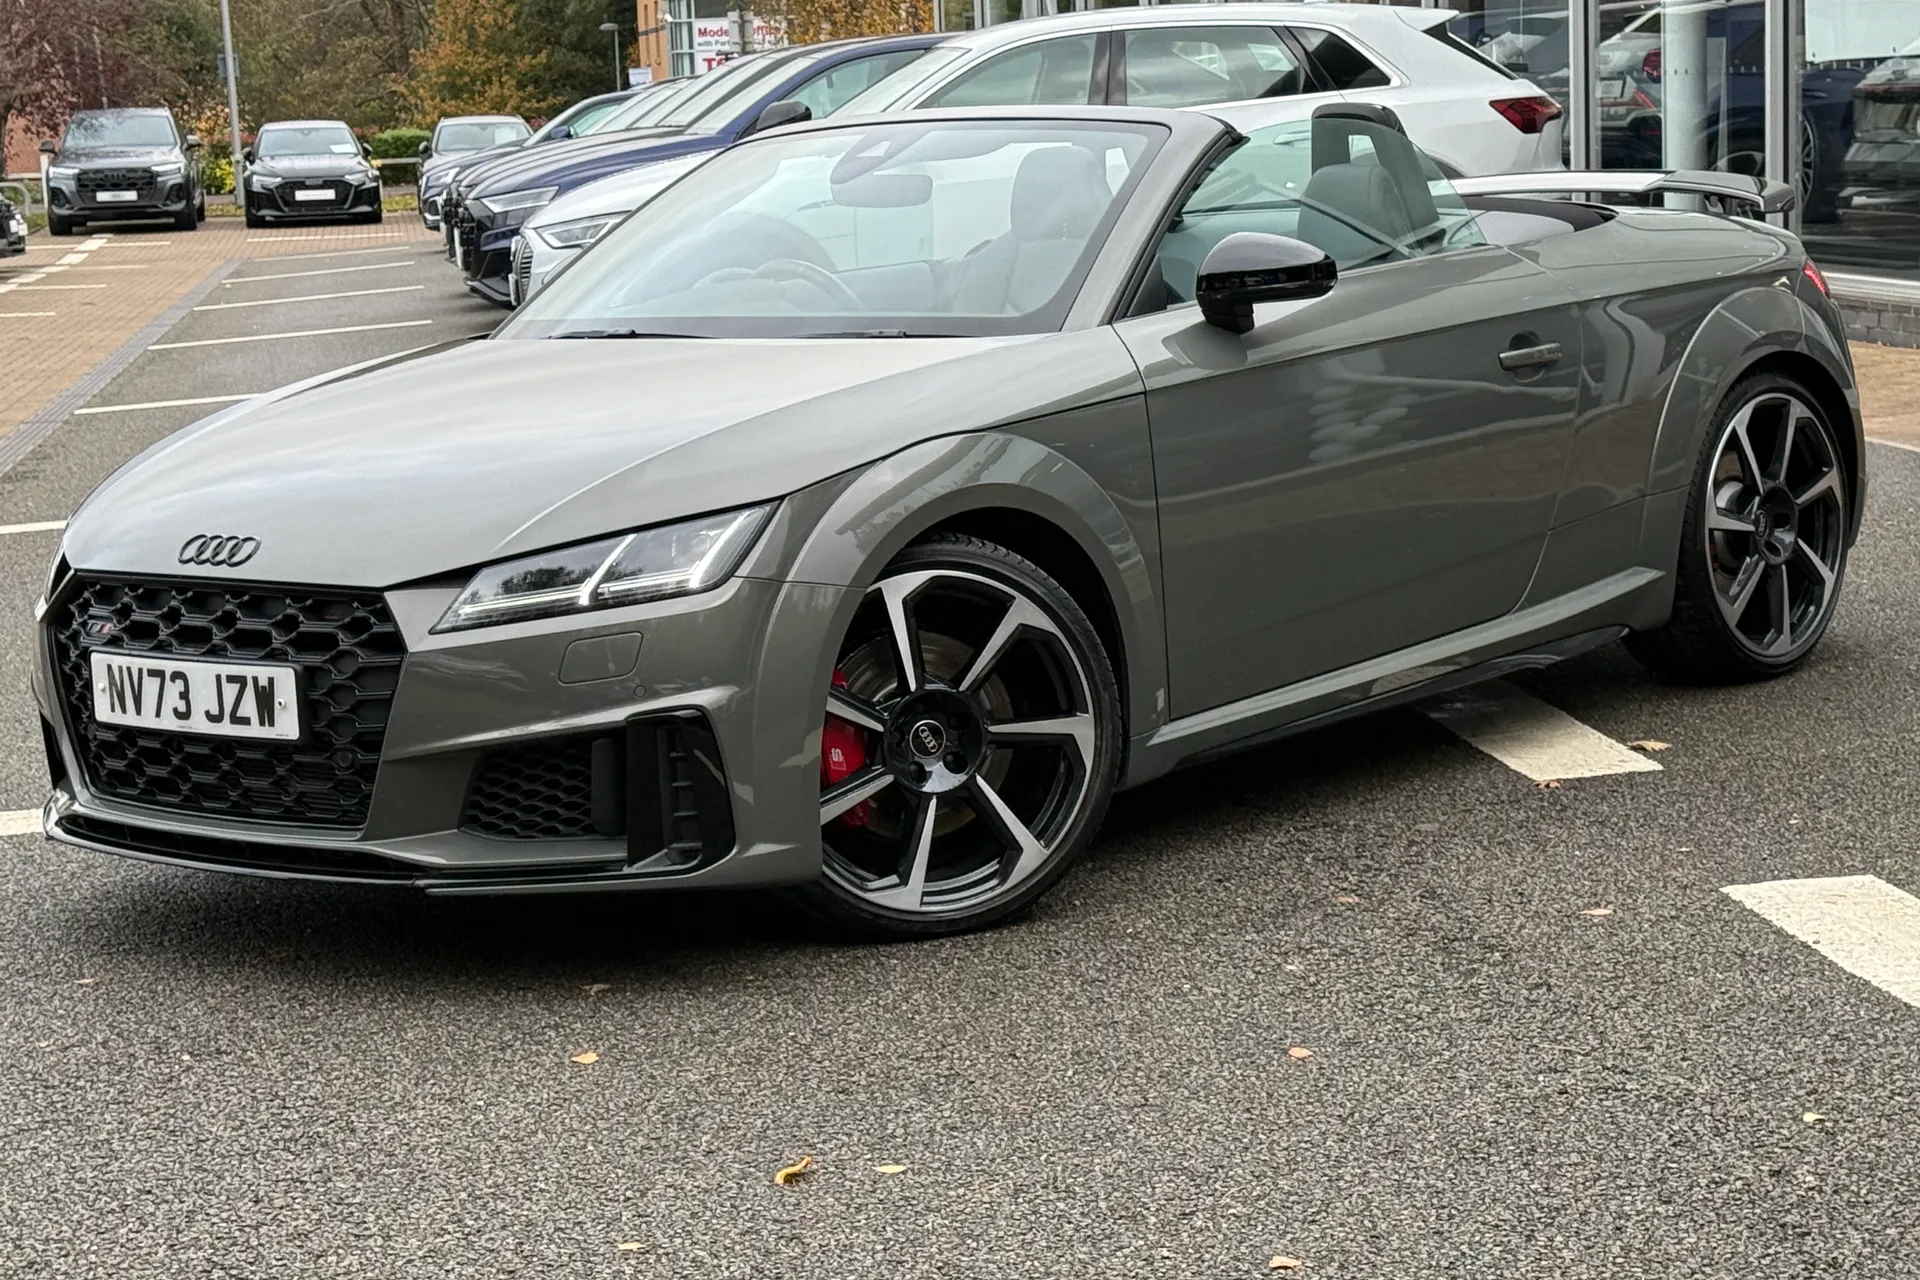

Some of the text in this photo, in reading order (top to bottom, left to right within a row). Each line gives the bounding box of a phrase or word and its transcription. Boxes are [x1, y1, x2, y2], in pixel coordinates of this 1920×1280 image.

[698, 26, 729, 37] Mode
[106, 663, 276, 728] NV73 JZW
